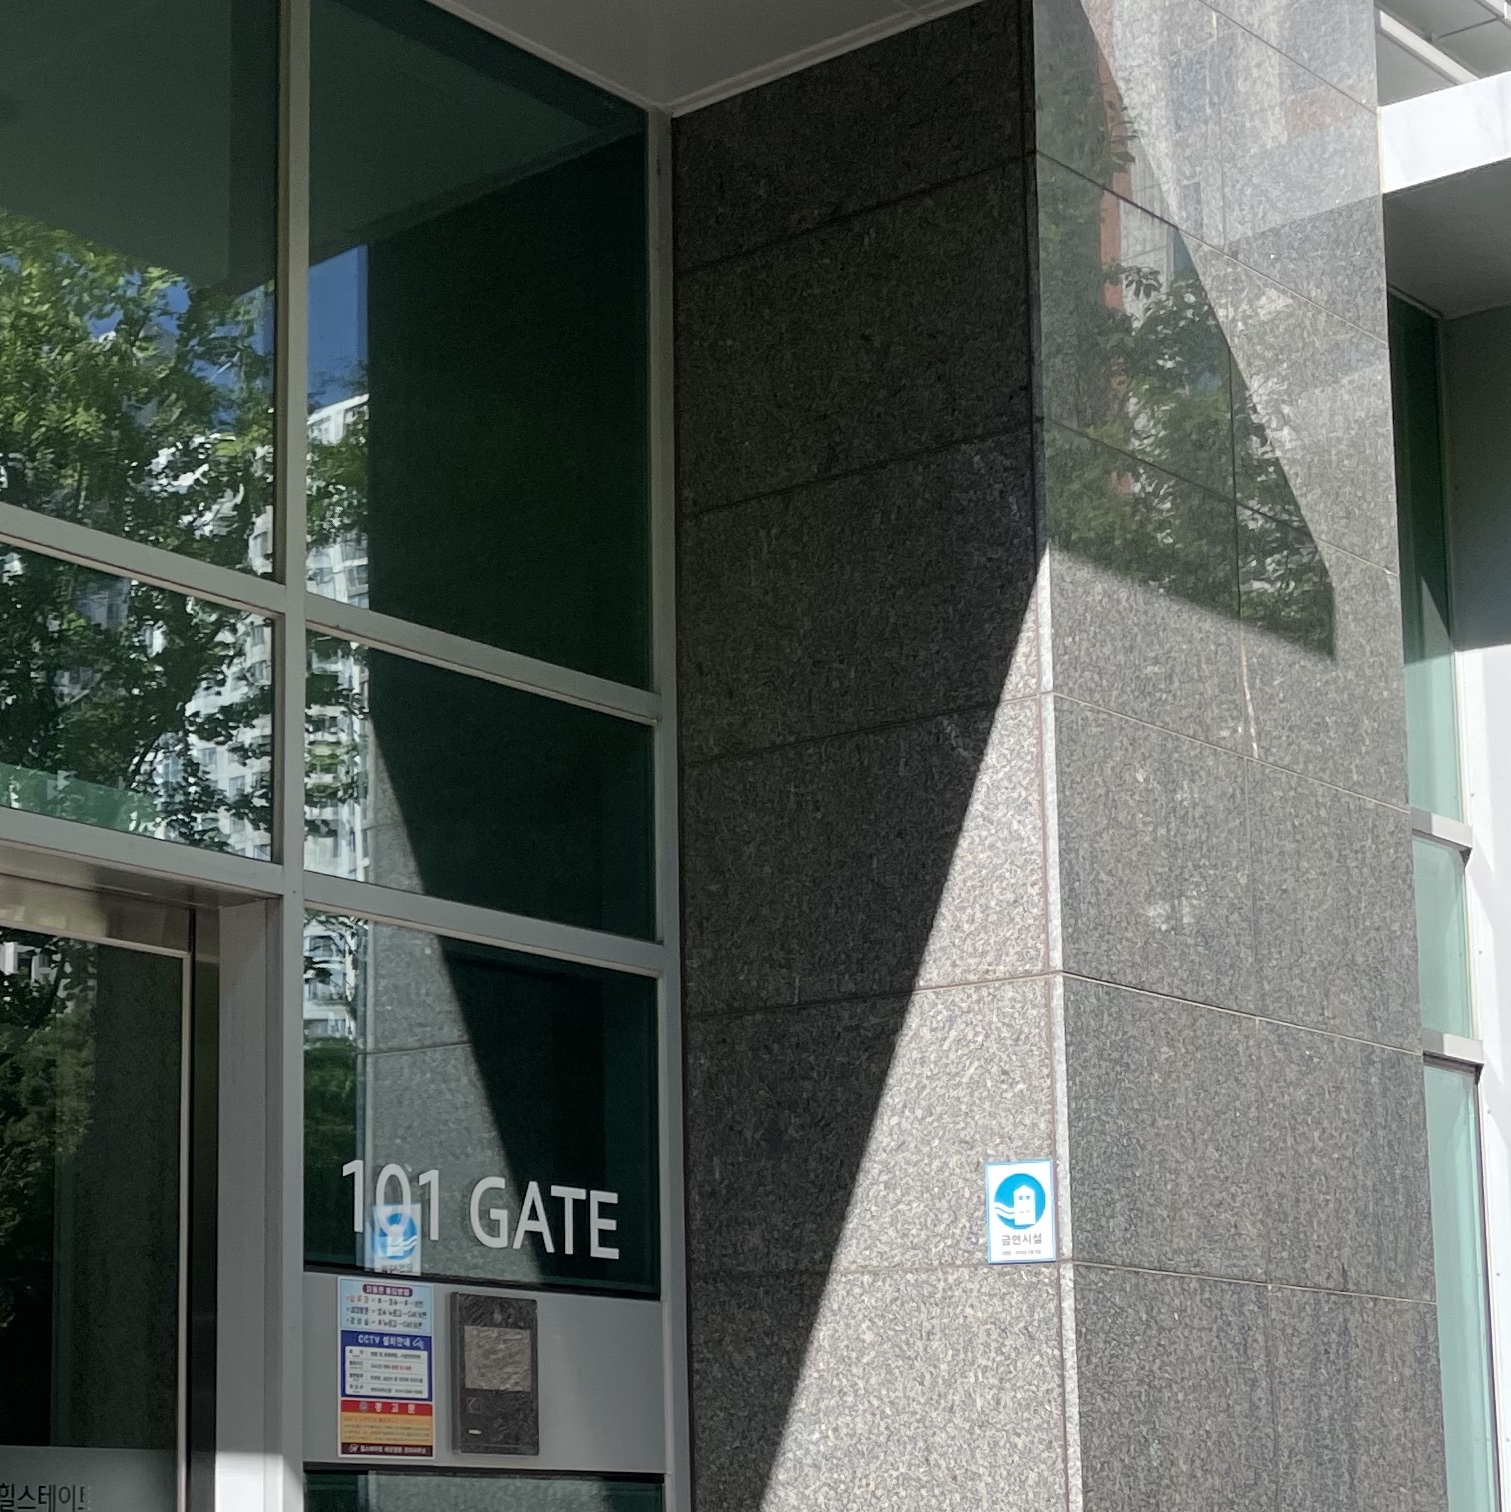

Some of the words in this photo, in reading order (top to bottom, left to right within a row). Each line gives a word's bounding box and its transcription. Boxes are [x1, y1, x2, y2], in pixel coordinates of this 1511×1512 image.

[342, 1159, 439, 1241] 101
[470, 1175, 620, 1260] GATE
[1001, 1233, 1042, 1246] 금연시설
[357, 1334, 381, 1345] CCTV
